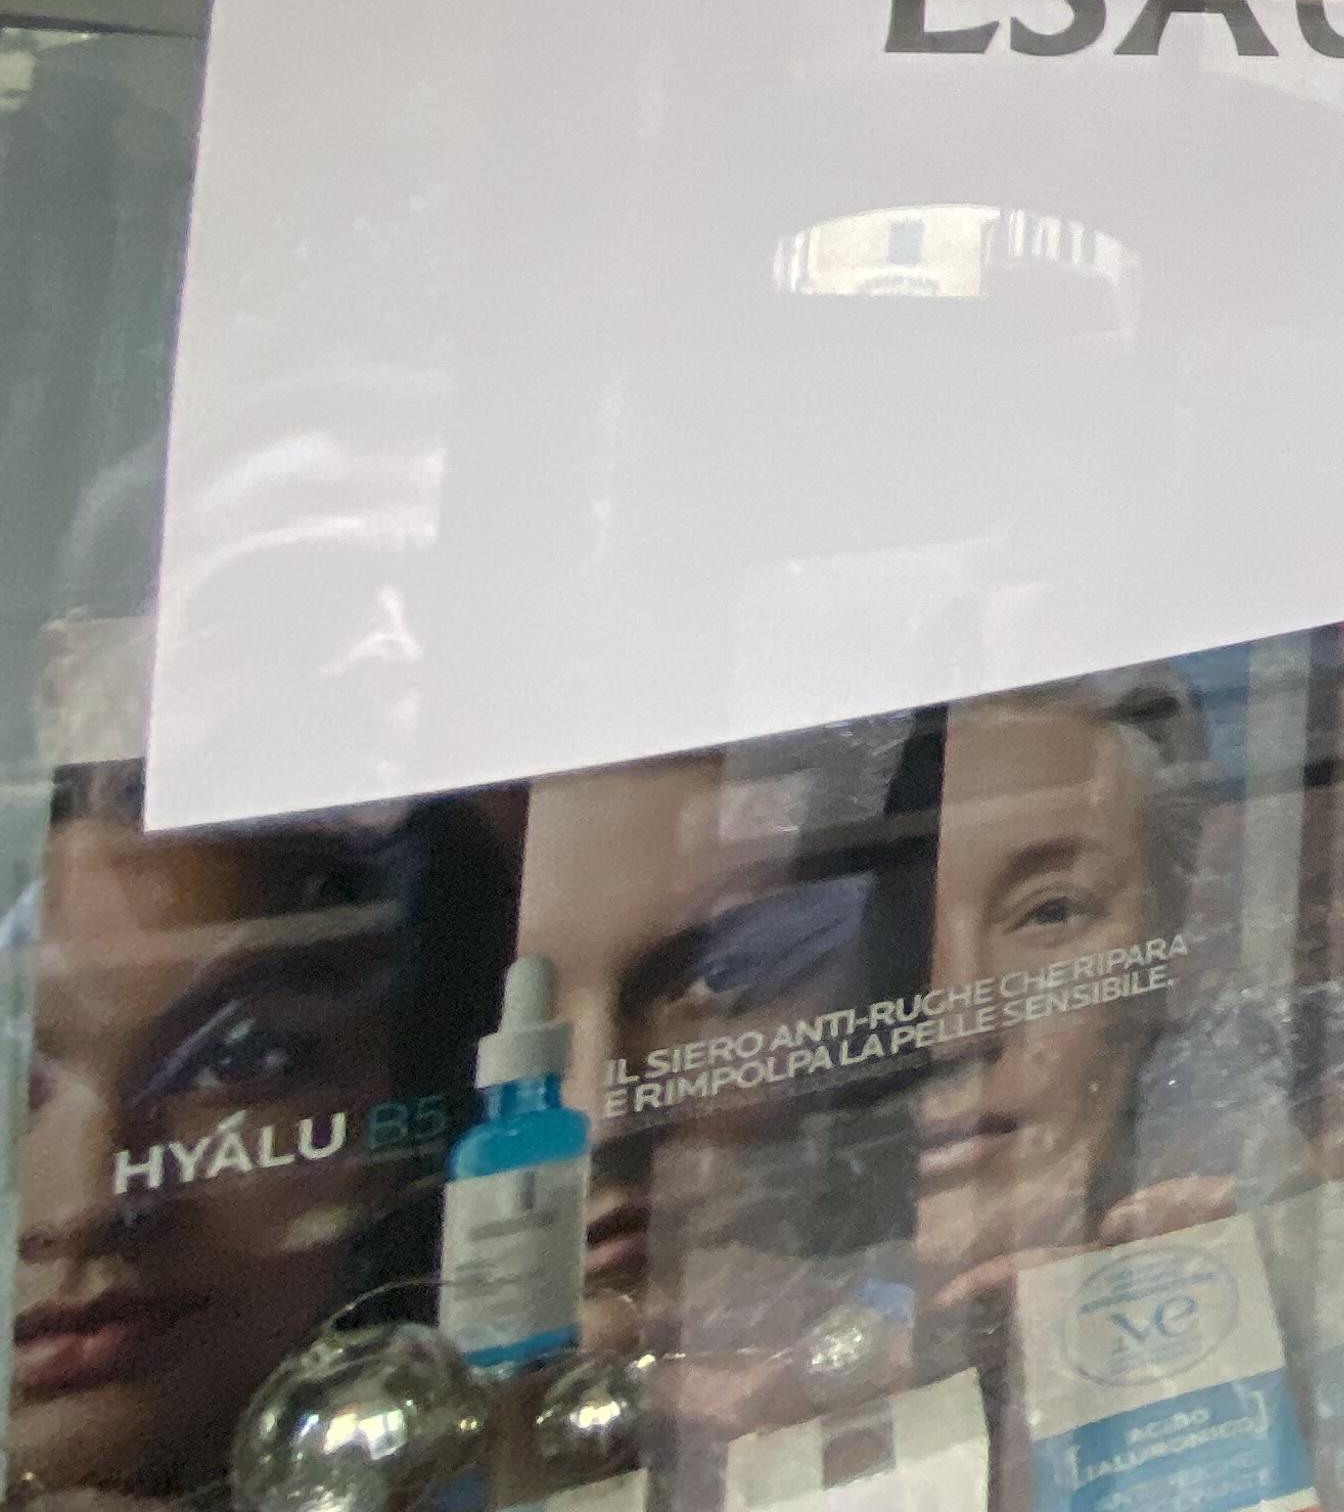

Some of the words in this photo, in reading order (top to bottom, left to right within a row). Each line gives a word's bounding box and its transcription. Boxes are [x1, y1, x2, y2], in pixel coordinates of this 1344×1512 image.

[603, 1056, 640, 1087] IL
[645, 1031, 764, 1080] SIERO
[999, 961, 1070, 999] CHE
[1070, 933, 1189, 981] RIPARA
[604, 1089, 628, 1120] E
[633, 1048, 834, 1112] RIMPOLPA
[838, 1034, 883, 1068] LA
[888, 1008, 997, 1058] PELLE
